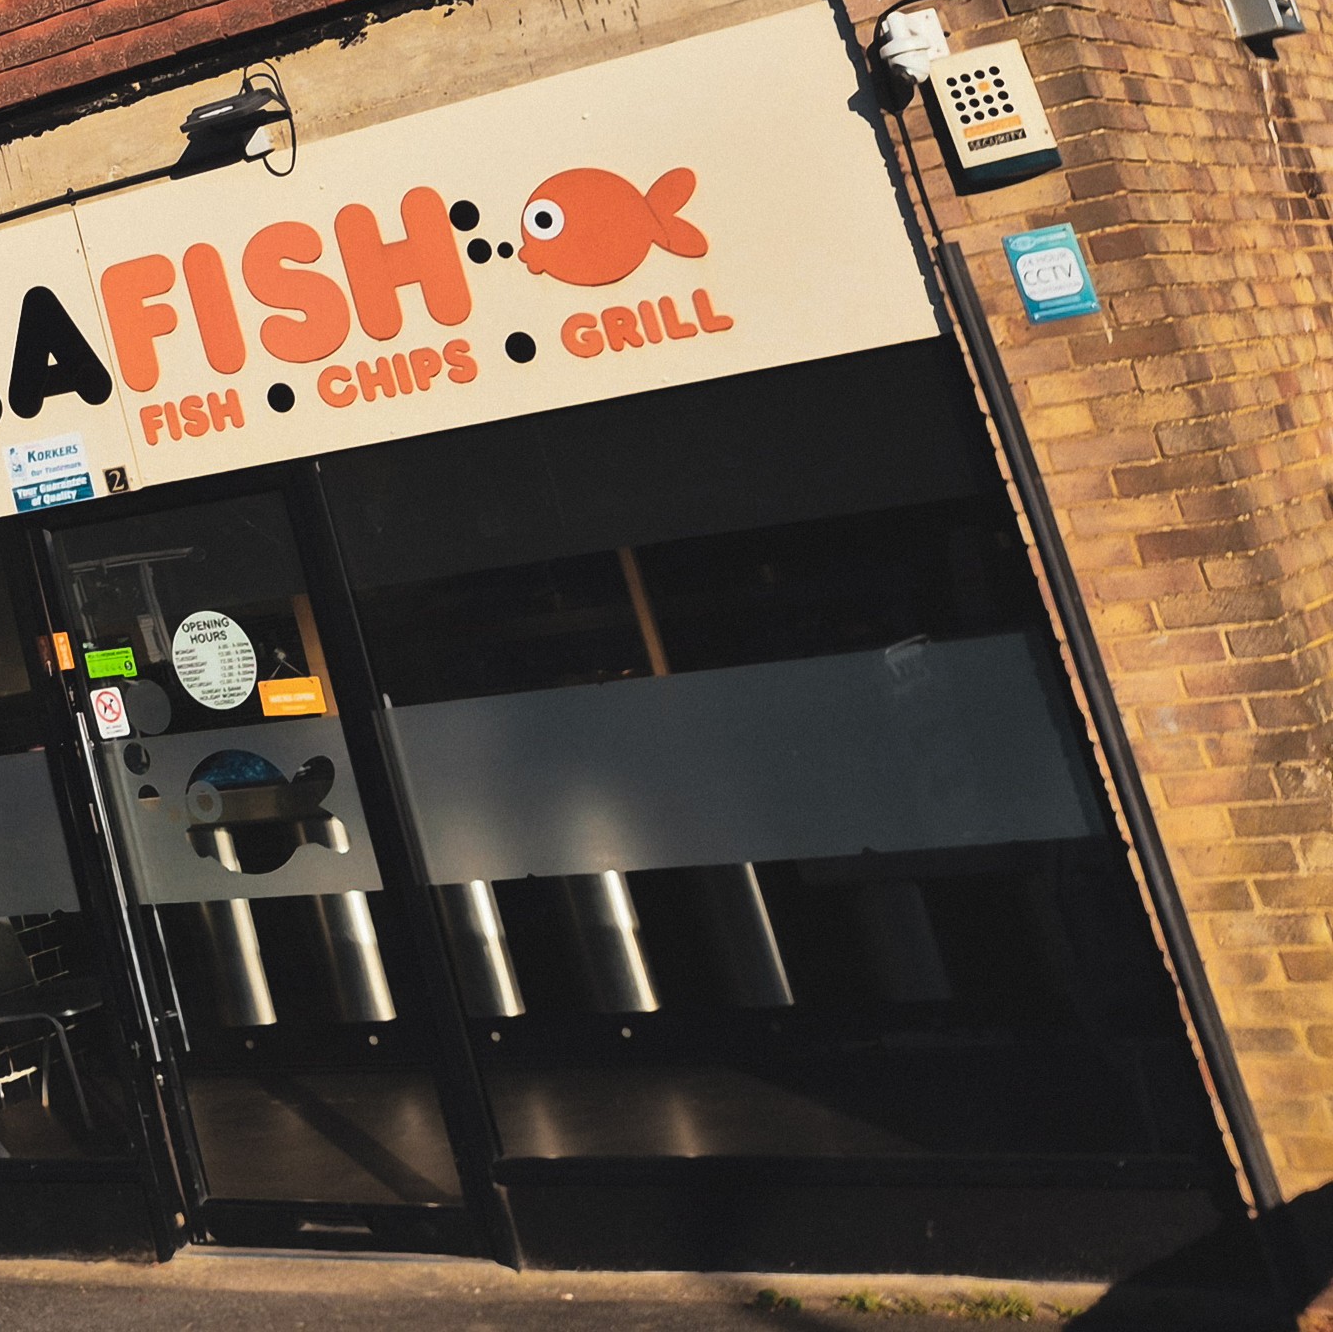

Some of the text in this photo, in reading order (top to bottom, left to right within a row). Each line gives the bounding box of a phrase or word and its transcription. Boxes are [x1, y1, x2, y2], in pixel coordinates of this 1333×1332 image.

[1023, 263, 1072, 286] CCTV
[99, 184, 474, 393] FISH
[138, 287, 735, 446] FISH CHIPS GRILL
[27, 444, 78, 463] KORKERS
[108, 470, 125, 492] 2
[42, 490, 77, 505] Quality
[182, 617, 230, 633] OPENING
[190, 631, 228, 644] HOURS
